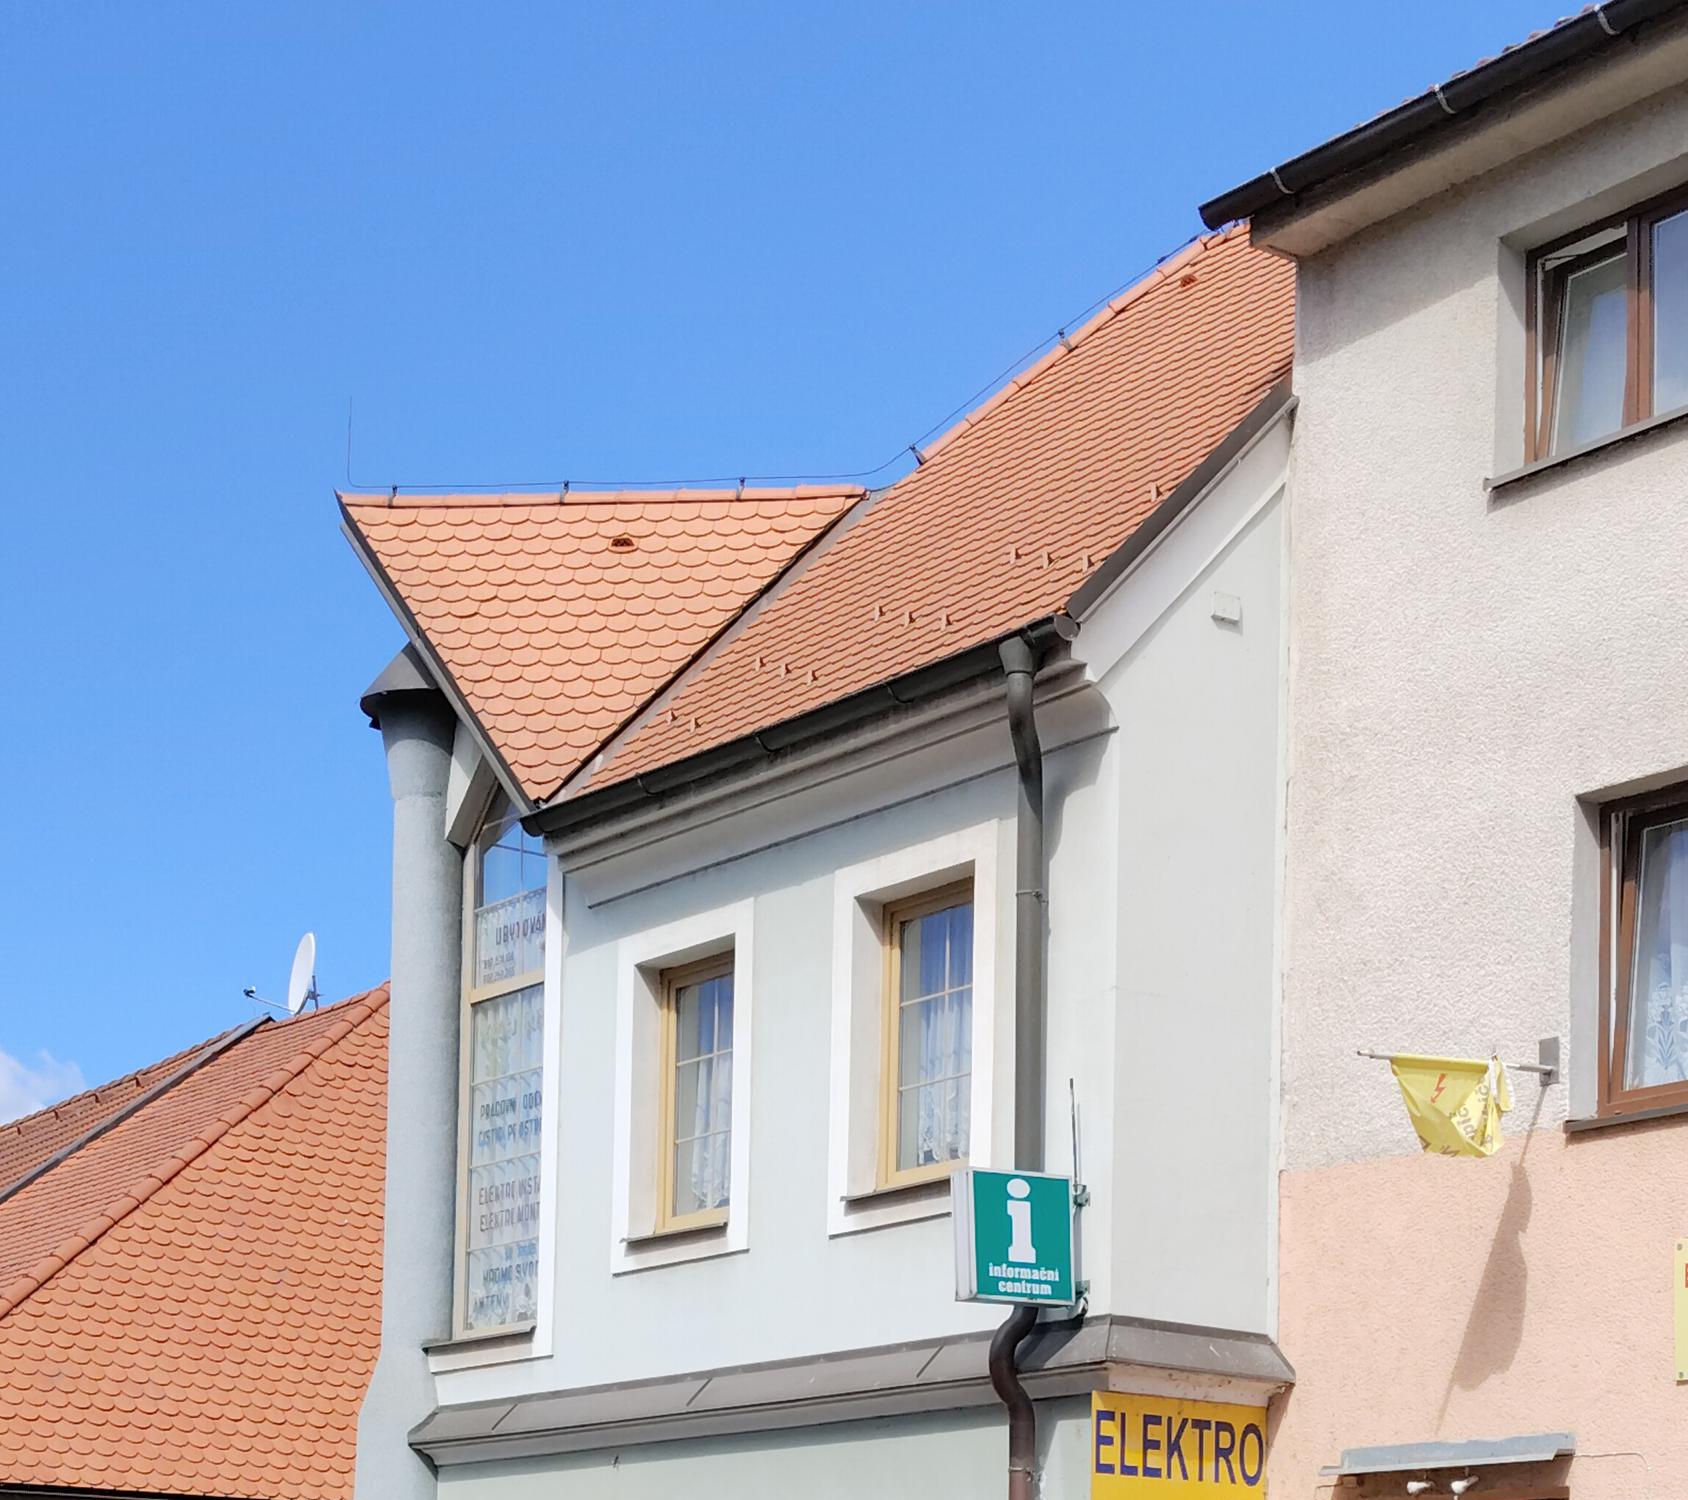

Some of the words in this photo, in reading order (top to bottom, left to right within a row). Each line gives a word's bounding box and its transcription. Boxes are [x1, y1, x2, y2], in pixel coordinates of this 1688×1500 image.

[988, 1262, 1060, 1282] informační
[998, 1280, 1052, 1296] centrum
[1095, 1409, 1264, 1487] ELEKTRO
